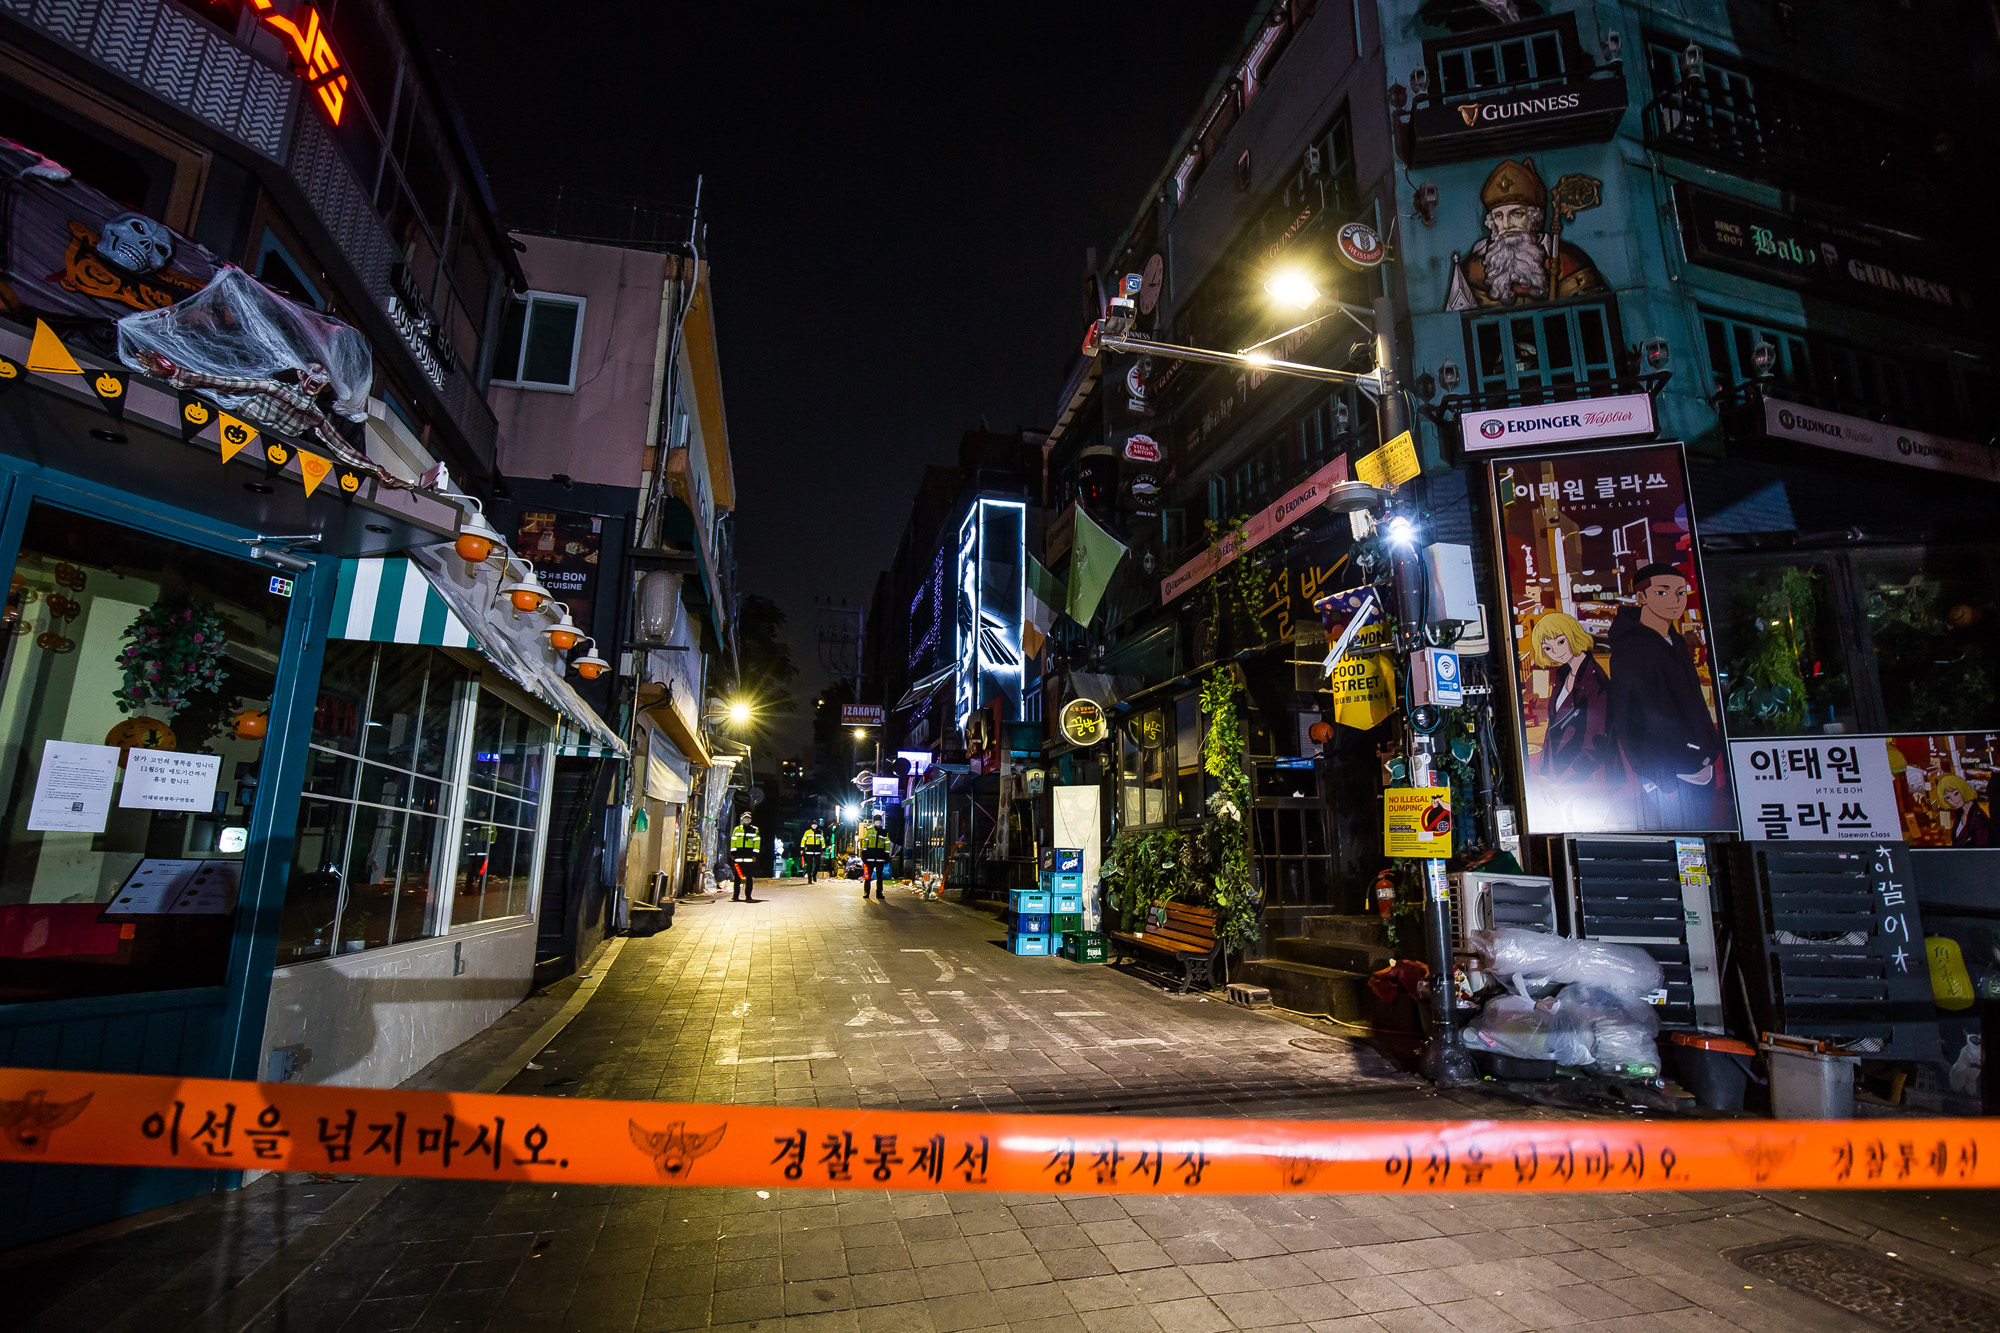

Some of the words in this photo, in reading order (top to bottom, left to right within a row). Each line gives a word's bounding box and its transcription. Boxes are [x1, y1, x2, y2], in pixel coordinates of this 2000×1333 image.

[1482, 93, 1580, 121] GUINNESS
[1269, 205, 1312, 258] GUINNESS
[1714, 220, 1742, 236] SINCE
[1716, 231, 1744, 248] 2007
[1848, 258, 1952, 307] GUINNESS
[437, 327, 458, 371] BON
[1508, 414, 1582, 433] ERDINGER
[1583, 411, 1633, 427] Weißbier
[1796, 415, 1843, 438] ERDINGER
[1133, 443, 1154, 451] STELLA
[1134, 448, 1155, 457] ARTOIS
[1515, 479, 1585, 501] 이태원
[1594, 473, 1668, 498] 클라쓰
[1285, 486, 1317, 514] ERDINGER
[1536, 504, 1596, 514] ITAEWON
[1609, 499, 1651, 508] CLASS
[562, 572, 587, 581] BON
[546, 581, 583, 591] CUISINE
[1332, 663, 1365, 680] FOOD
[1334, 675, 1380, 693] STREET
[843, 706, 880, 716] IZAKAYA
[140, 765, 165, 774] 11월5일
[195, 761, 216, 770] 빕니다.
[1750, 745, 1862, 784] 이태원
[1388, 796, 1400, 804] NO
[1400, 795, 1430, 803] ILLEGAL
[1388, 804, 1424, 812] DUMPING
[1757, 801, 1872, 840] 클라쓰
[1838, 831, 1869, 839] Itaewon
[141, 1101, 291, 1161] 이선을
[316, 1109, 571, 1171] 넘지마시오.
[770, 1129, 991, 1186] 경찰통제선
[1043, 1137, 1210, 1188] 경찰서장
[1384, 1141, 1493, 1188] 이선을
[1830, 1138, 1979, 1180] 경찰통제선
